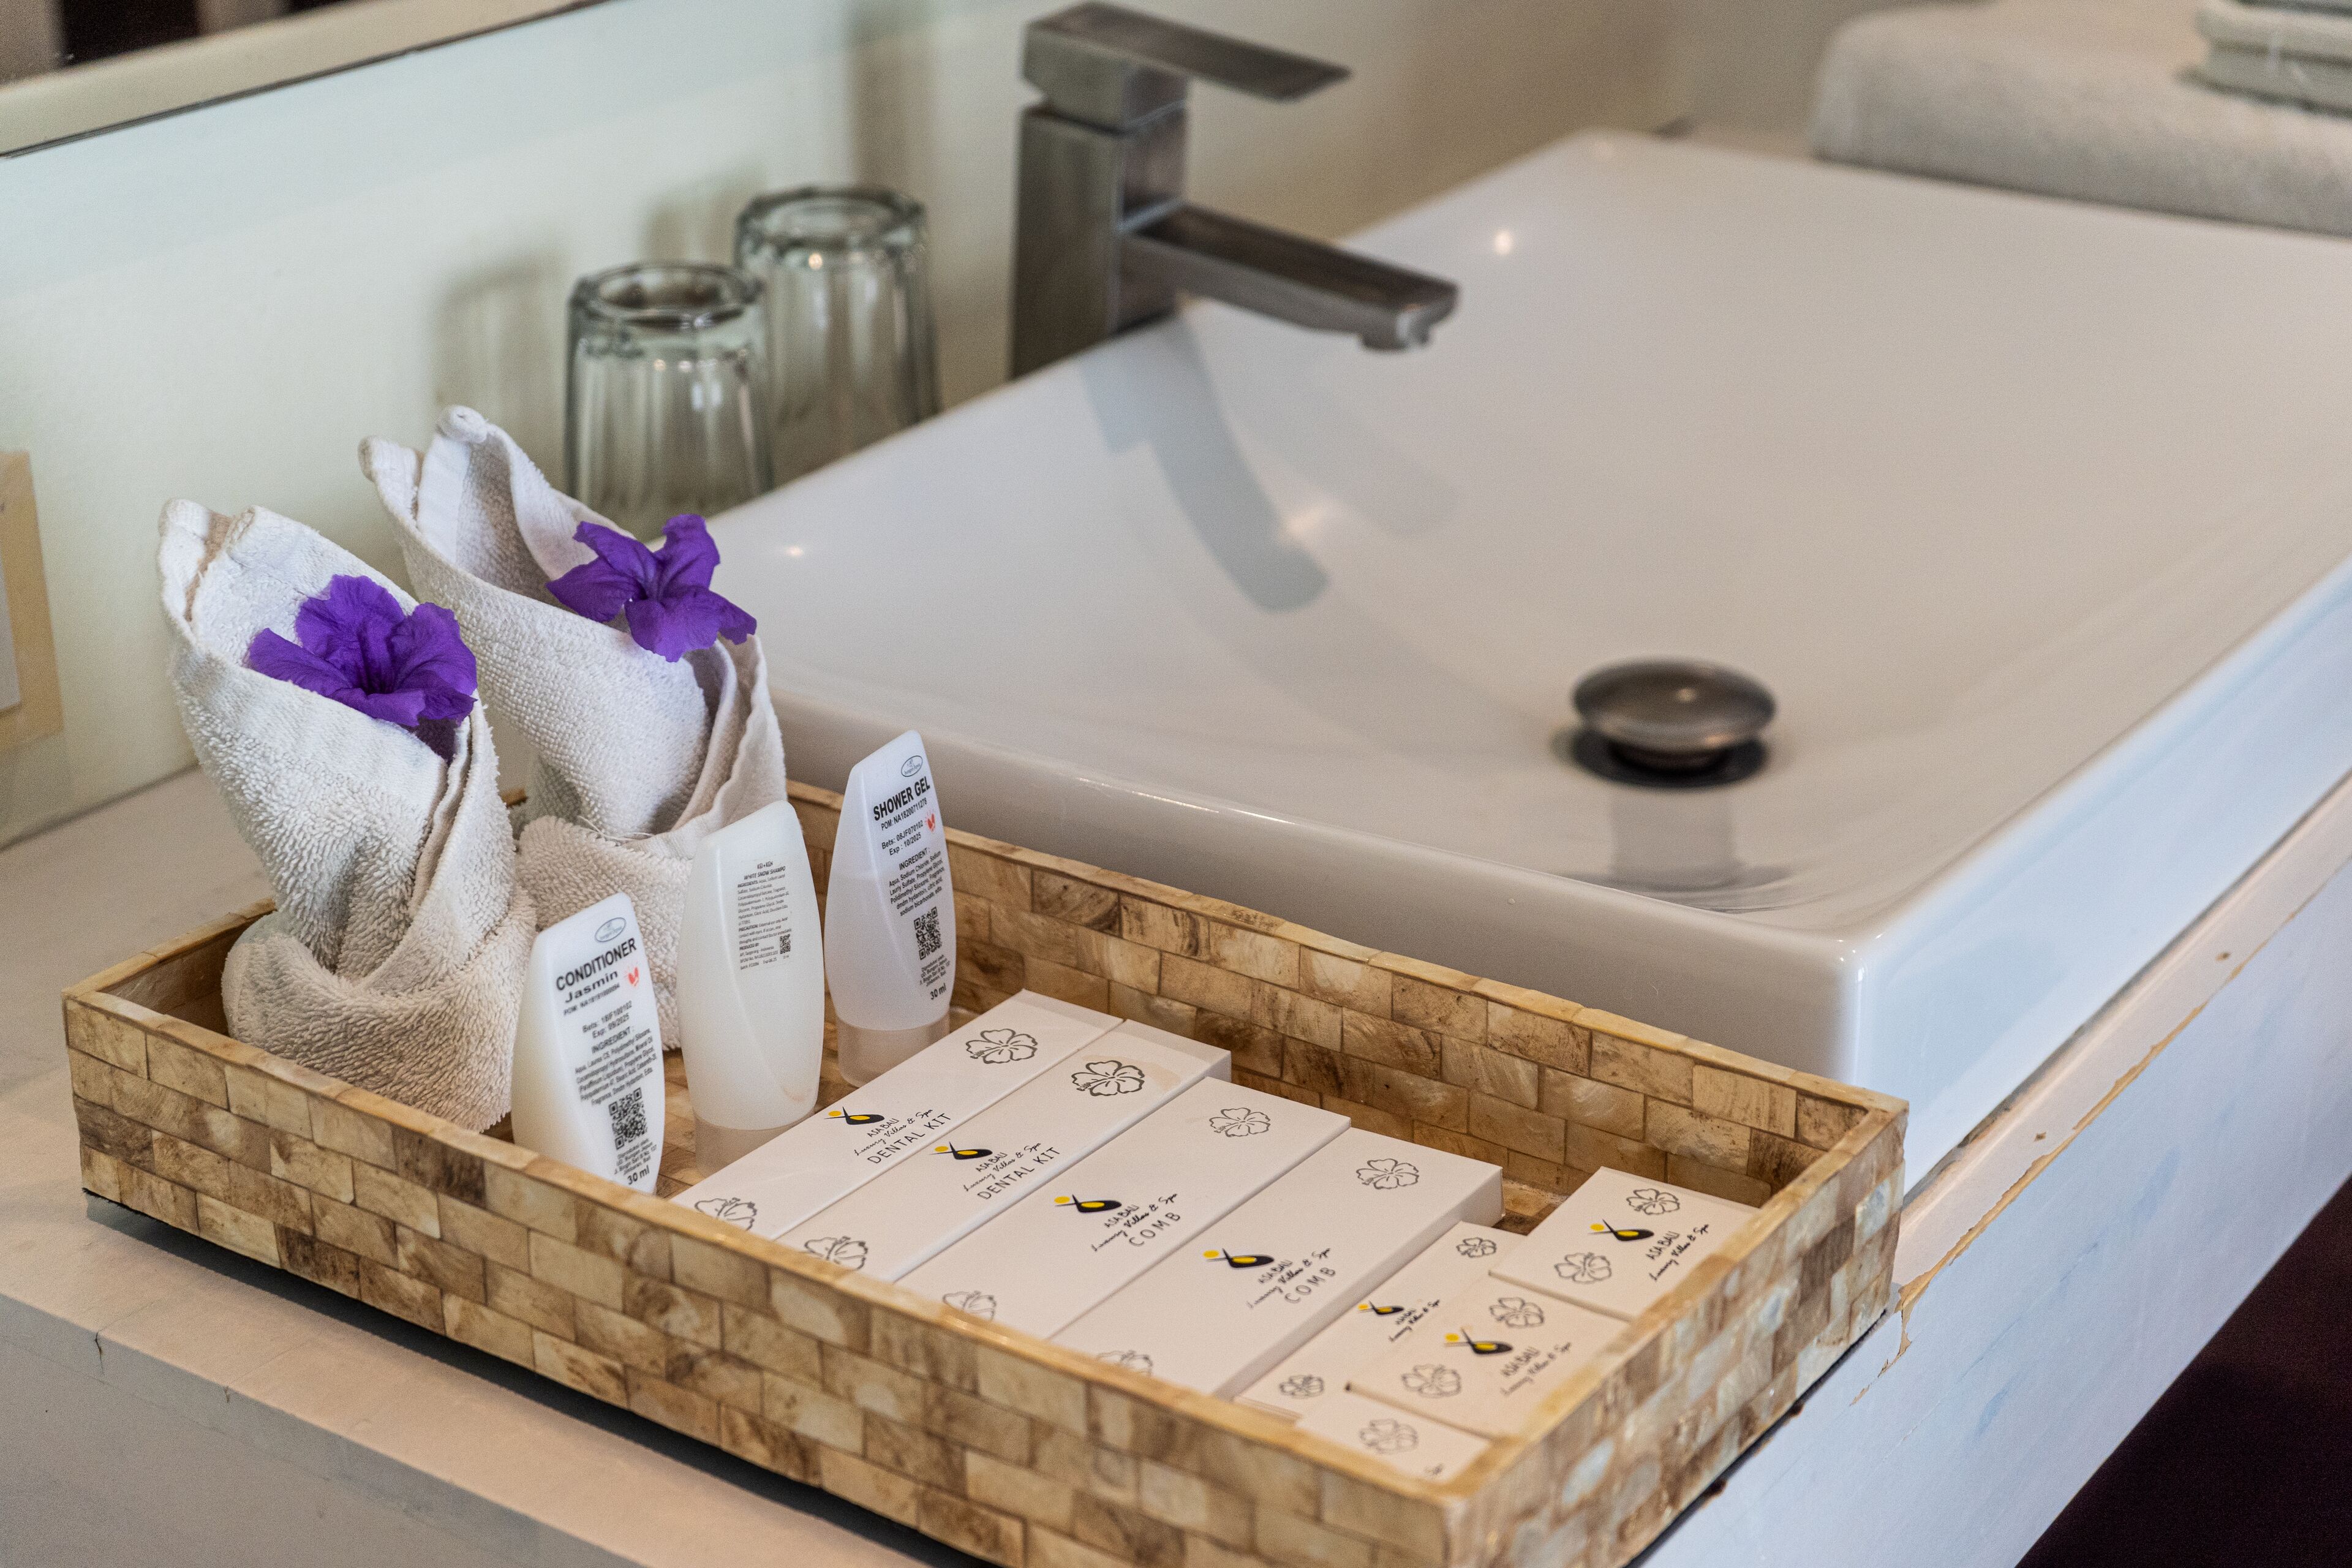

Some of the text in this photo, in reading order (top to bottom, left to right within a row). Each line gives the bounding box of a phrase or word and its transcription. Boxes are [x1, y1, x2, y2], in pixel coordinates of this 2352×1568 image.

[873, 776, 930, 821] SHOWER GEL
[883, 838, 895, 850] Bets:
[899, 848, 928, 871] INGREDIENT
[556, 937, 636, 990] CONDITIONER
[565, 971, 617, 1003] Jasmin
[930, 982, 946, 1000] 30 ml
[592, 1027, 630, 1054] INGREDIENT
[854, 1139, 886, 1155] Luxury
[884, 1125, 907, 1137] Villas
[916, 1109, 933, 1118] Spa
[867, 1113, 951, 1163] DENTAL KIT
[628, 1165, 649, 1186] 30 ml
[963, 1173, 996, 1191] Luxury
[993, 1158, 1016, 1172] Villas
[1024, 1143, 1041, 1153] Spa
[977, 1147, 1060, 1199] DENTAL KIT
[1129, 1212, 1181, 1247] COMB
[1284, 1267, 1336, 1303] COMB
